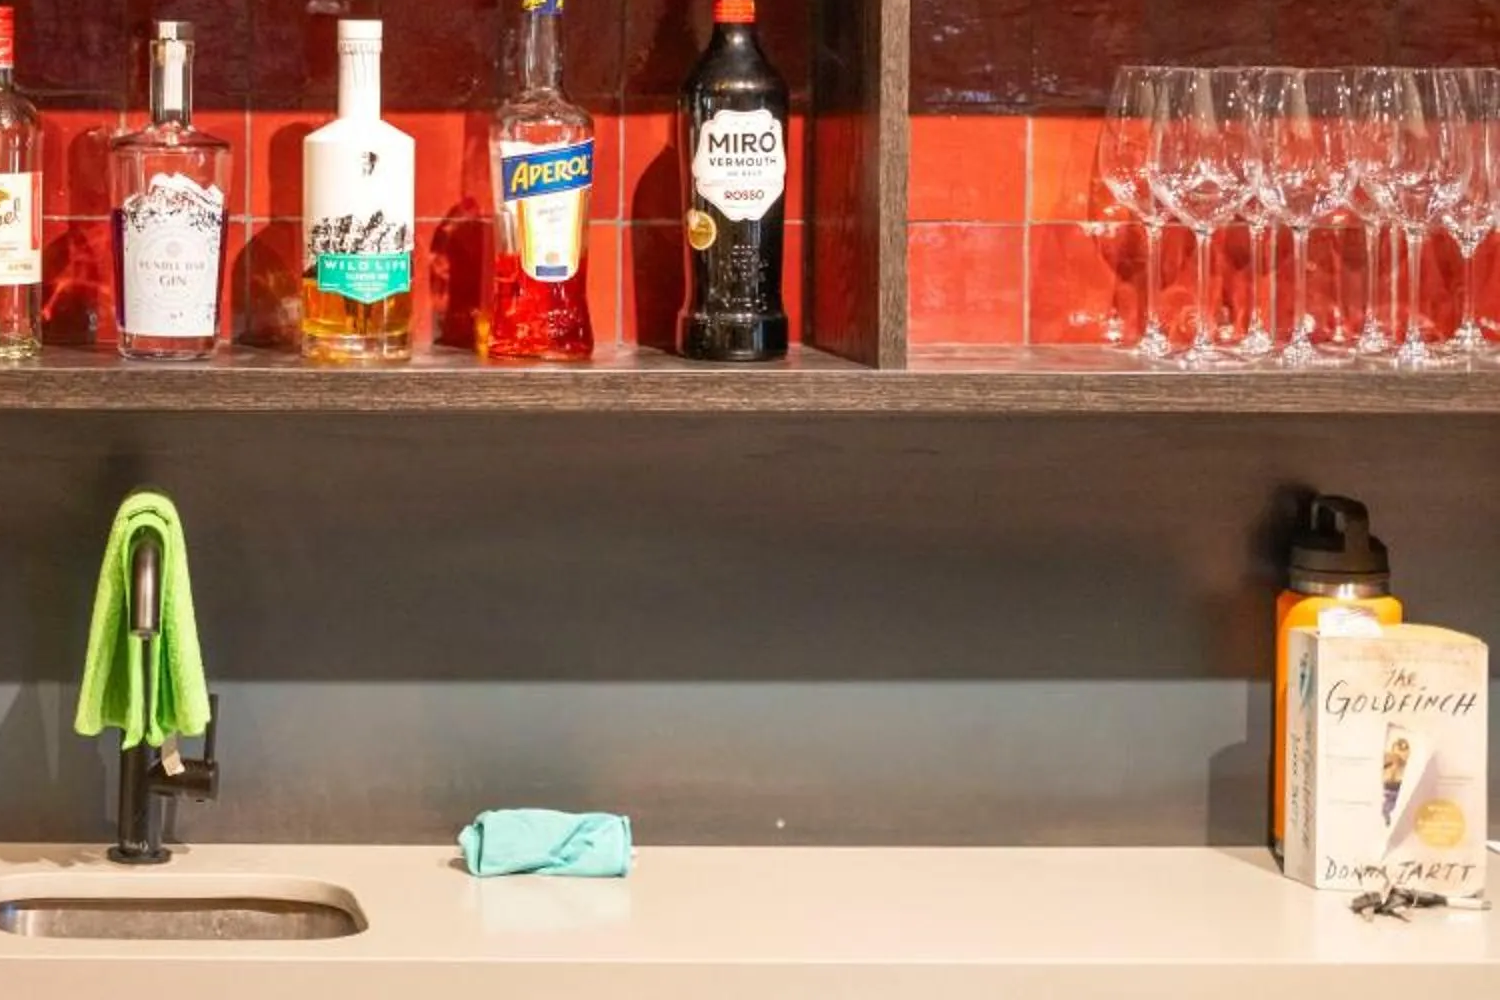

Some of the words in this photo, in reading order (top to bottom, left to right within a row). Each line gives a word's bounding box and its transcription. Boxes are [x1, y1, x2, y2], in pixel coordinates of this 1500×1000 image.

[708, 124, 777, 154] MIRÓ
[708, 157, 777, 167] VERMOUTH
[511, 154, 589, 193] APEROL
[724, 189, 764, 201] ROSSO
[325, 260, 370, 271] WILD
[1398, 860, 1477, 885] TARTT
